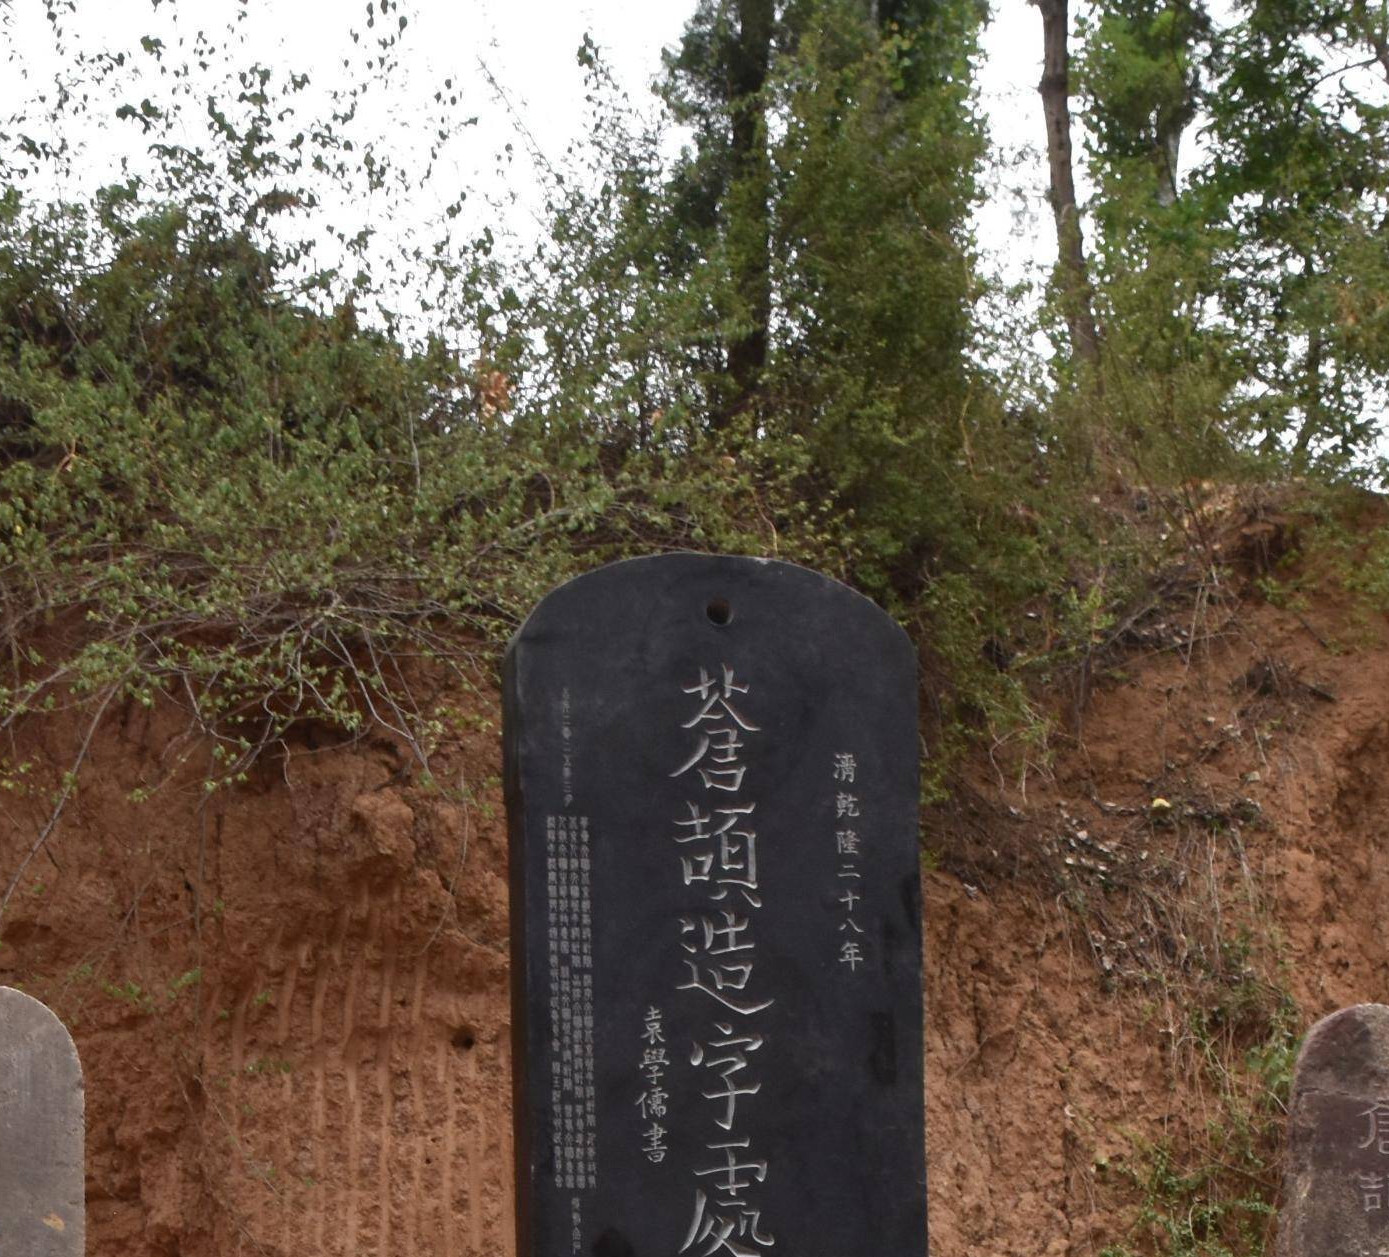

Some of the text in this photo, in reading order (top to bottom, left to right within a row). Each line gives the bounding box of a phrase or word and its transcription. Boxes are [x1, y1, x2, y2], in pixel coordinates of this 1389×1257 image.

[832, 752, 865, 972] 清乾隆二十八年
[635, 1005, 670, 1164] 袁學儒書
